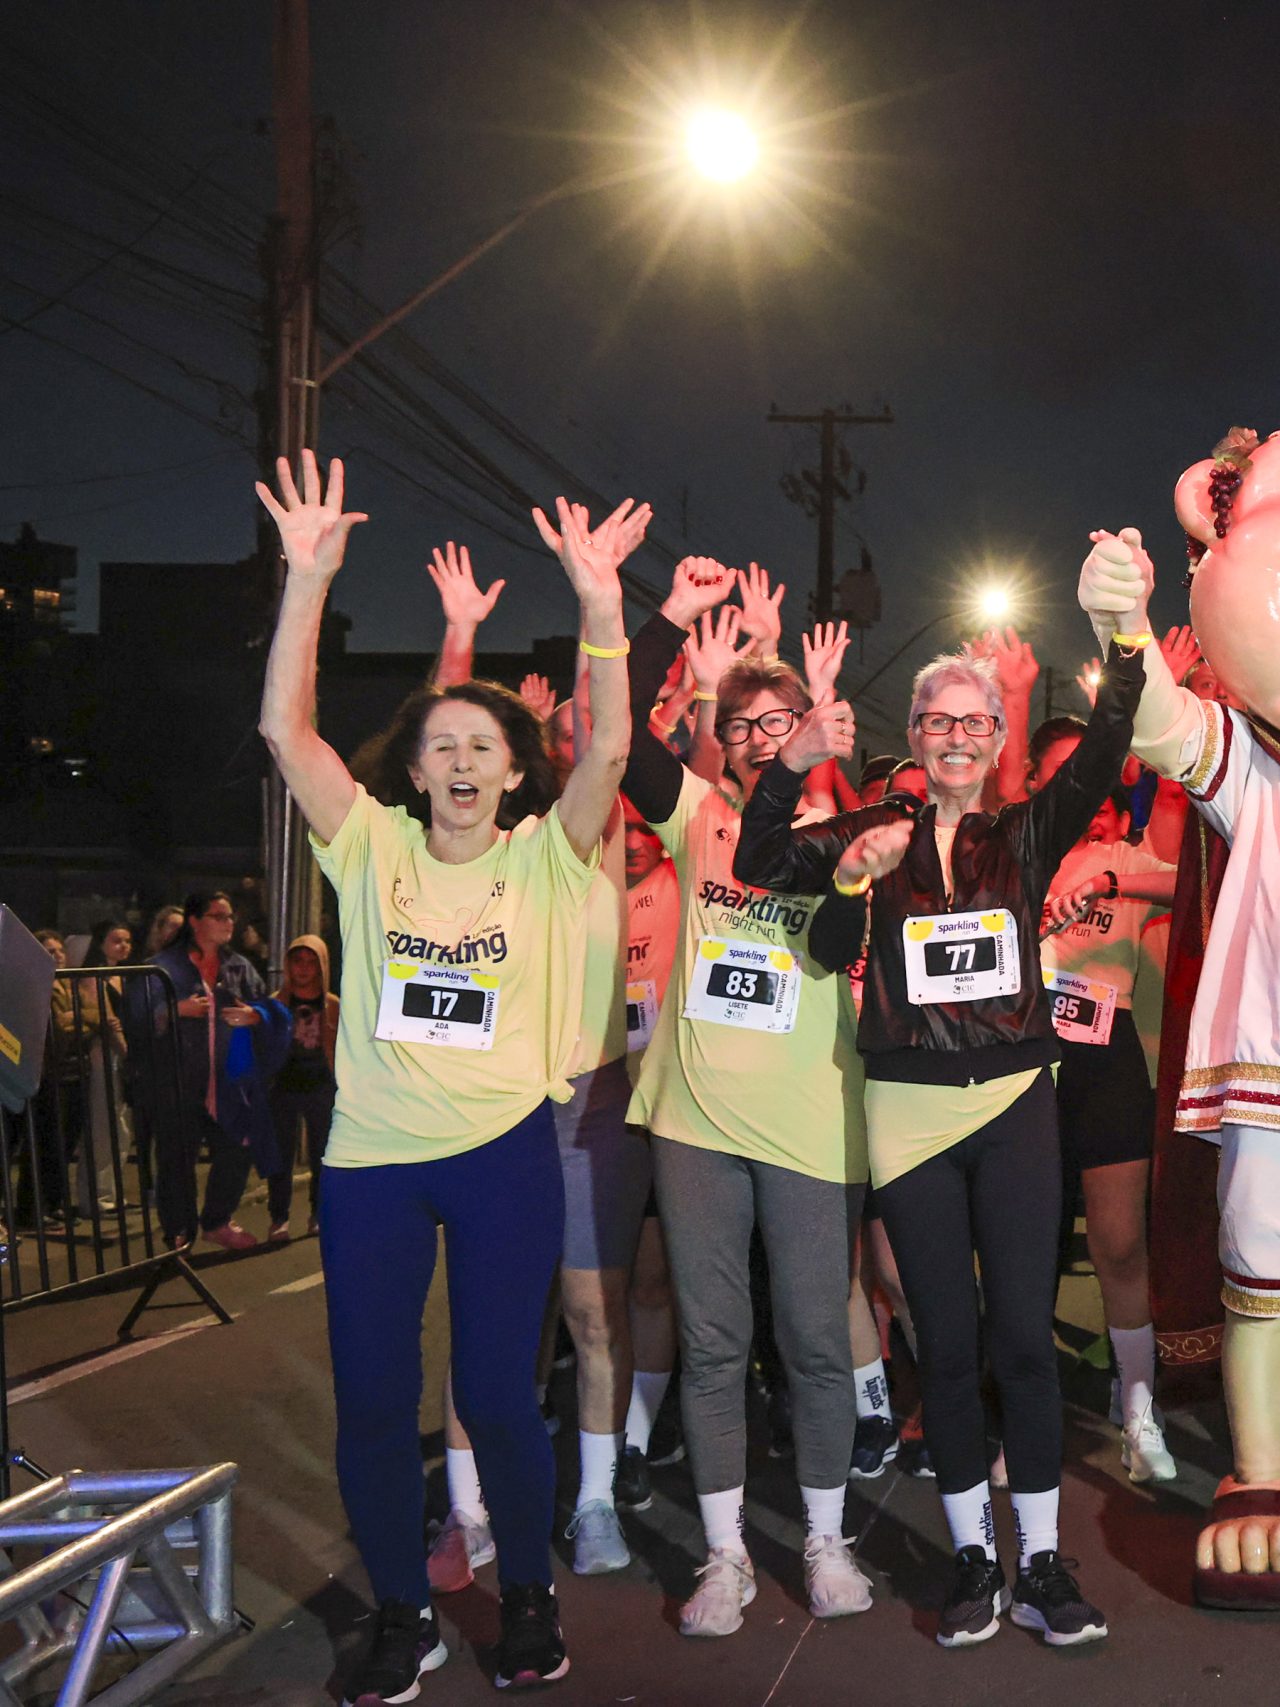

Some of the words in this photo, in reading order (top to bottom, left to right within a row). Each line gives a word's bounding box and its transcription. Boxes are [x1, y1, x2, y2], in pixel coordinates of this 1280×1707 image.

[699, 880, 808, 936] sparkling
[719, 911, 754, 932] night
[938, 920, 979, 935] sparkling
[729, 949, 768, 964] sparkling
[945, 943, 976, 972] 77
[996, 934, 1005, 976] CAMINHADA
[423, 970, 469, 983] sparkling
[725, 971, 759, 998] 83
[955, 975, 975, 983] MARIA
[1056, 978, 1088, 992] sparkling
[430, 990, 459, 1017] 17
[483, 991, 495, 1033] CAMINHADA
[1053, 995, 1080, 1019] 95
[435, 1022, 449, 1030] ADA
